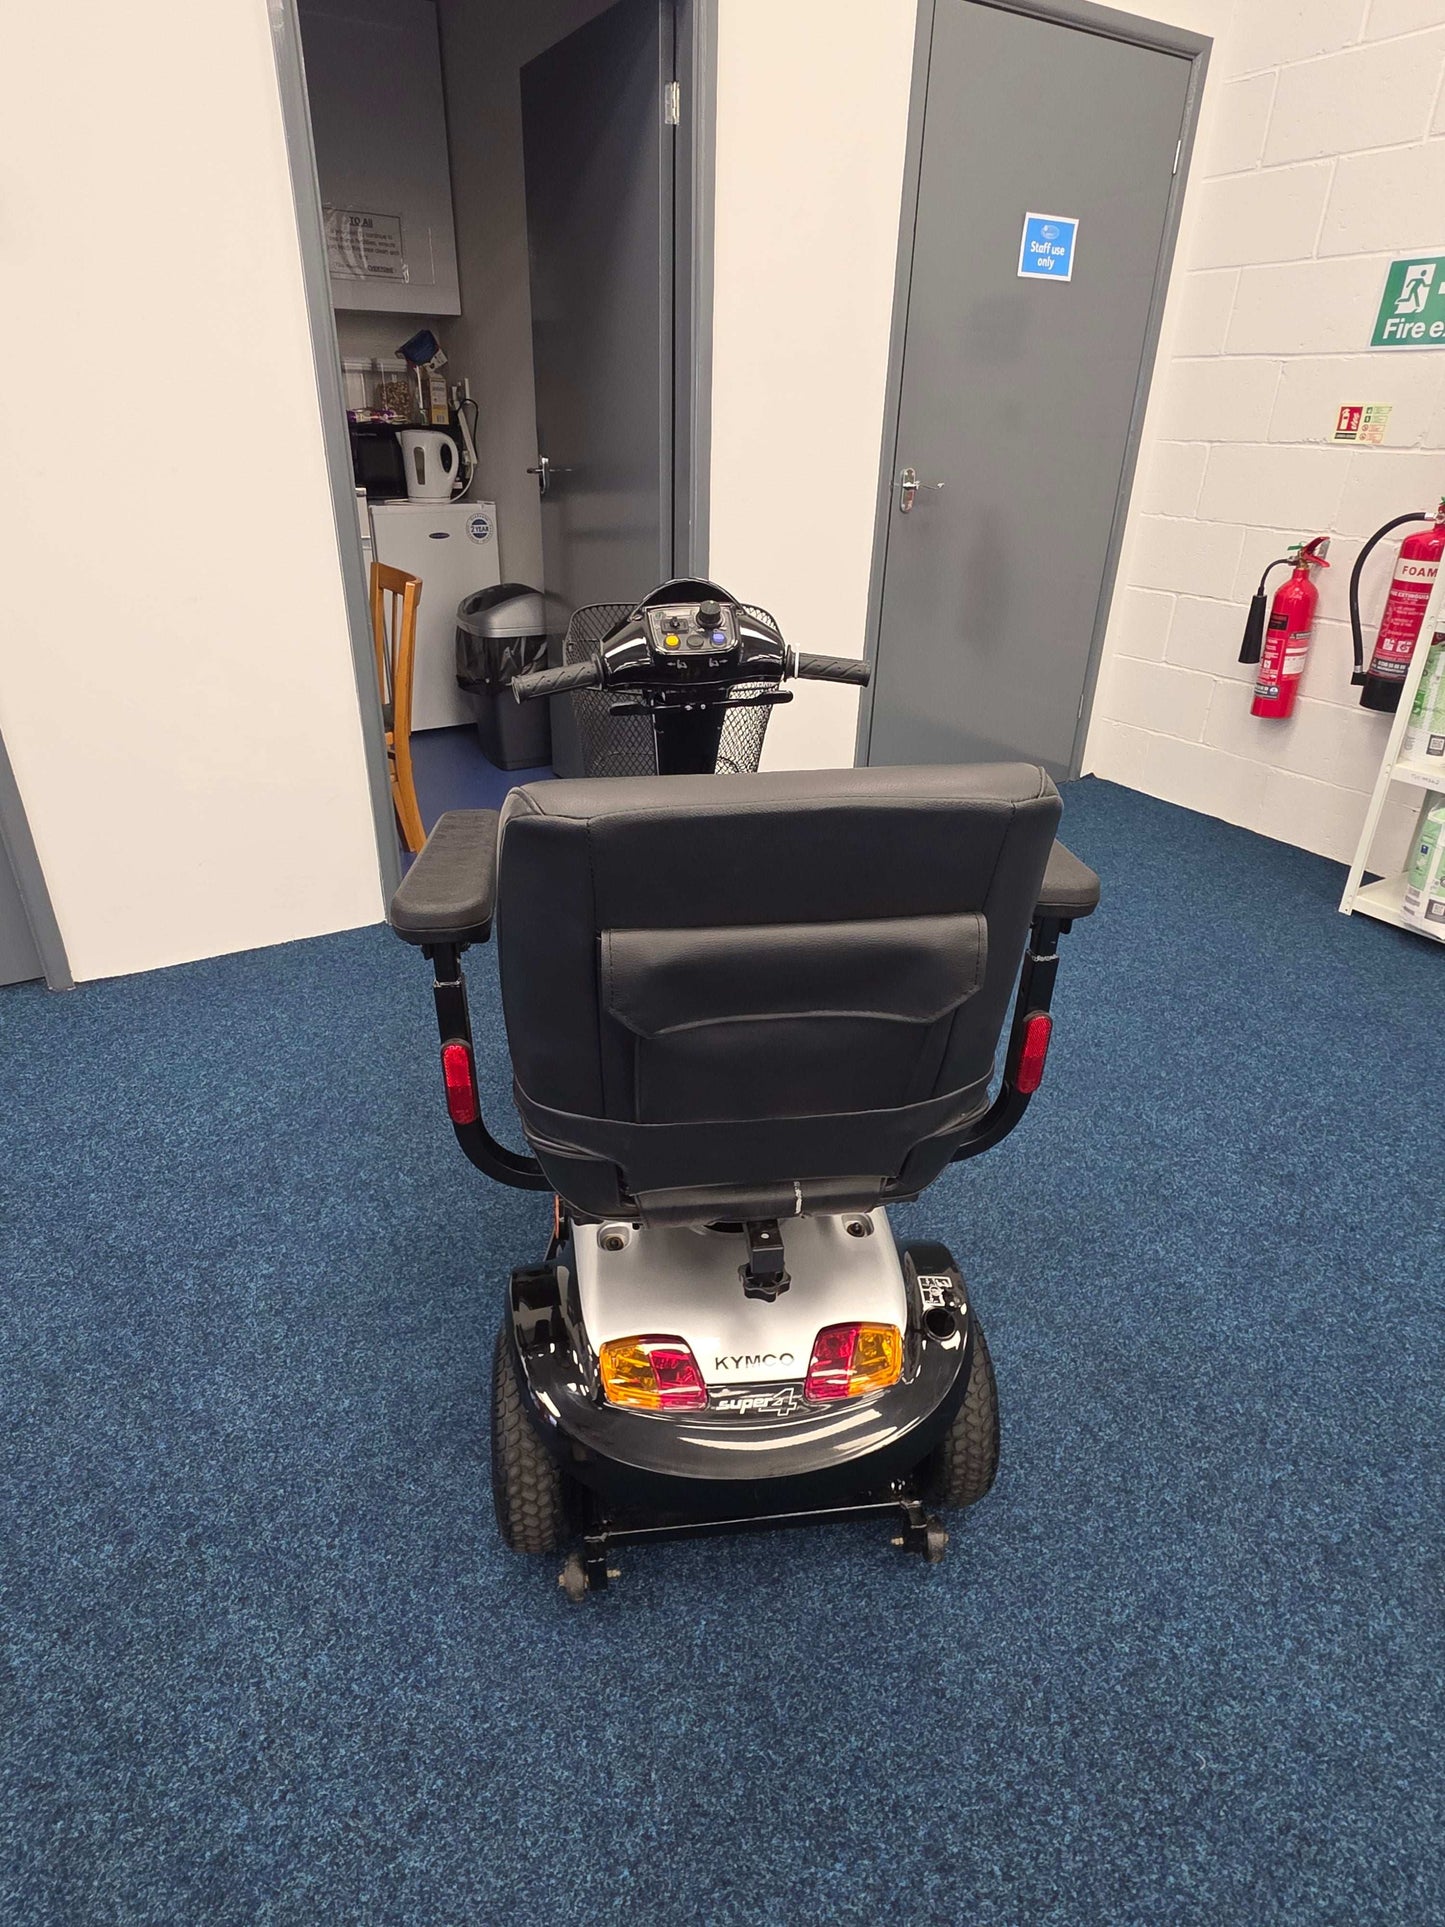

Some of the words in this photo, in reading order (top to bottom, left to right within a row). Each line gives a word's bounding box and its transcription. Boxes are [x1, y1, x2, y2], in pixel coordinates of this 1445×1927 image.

[1030, 240, 1052, 254] Staff
[1051, 246, 1065, 256] use
[1037, 256, 1055, 270] only
[1382, 318, 1426, 340] Fire
[1429, 320, 1445, 338] e
[1402, 565, 1439, 578] FOAM
[715, 1353, 795, 1370] KYMCO
